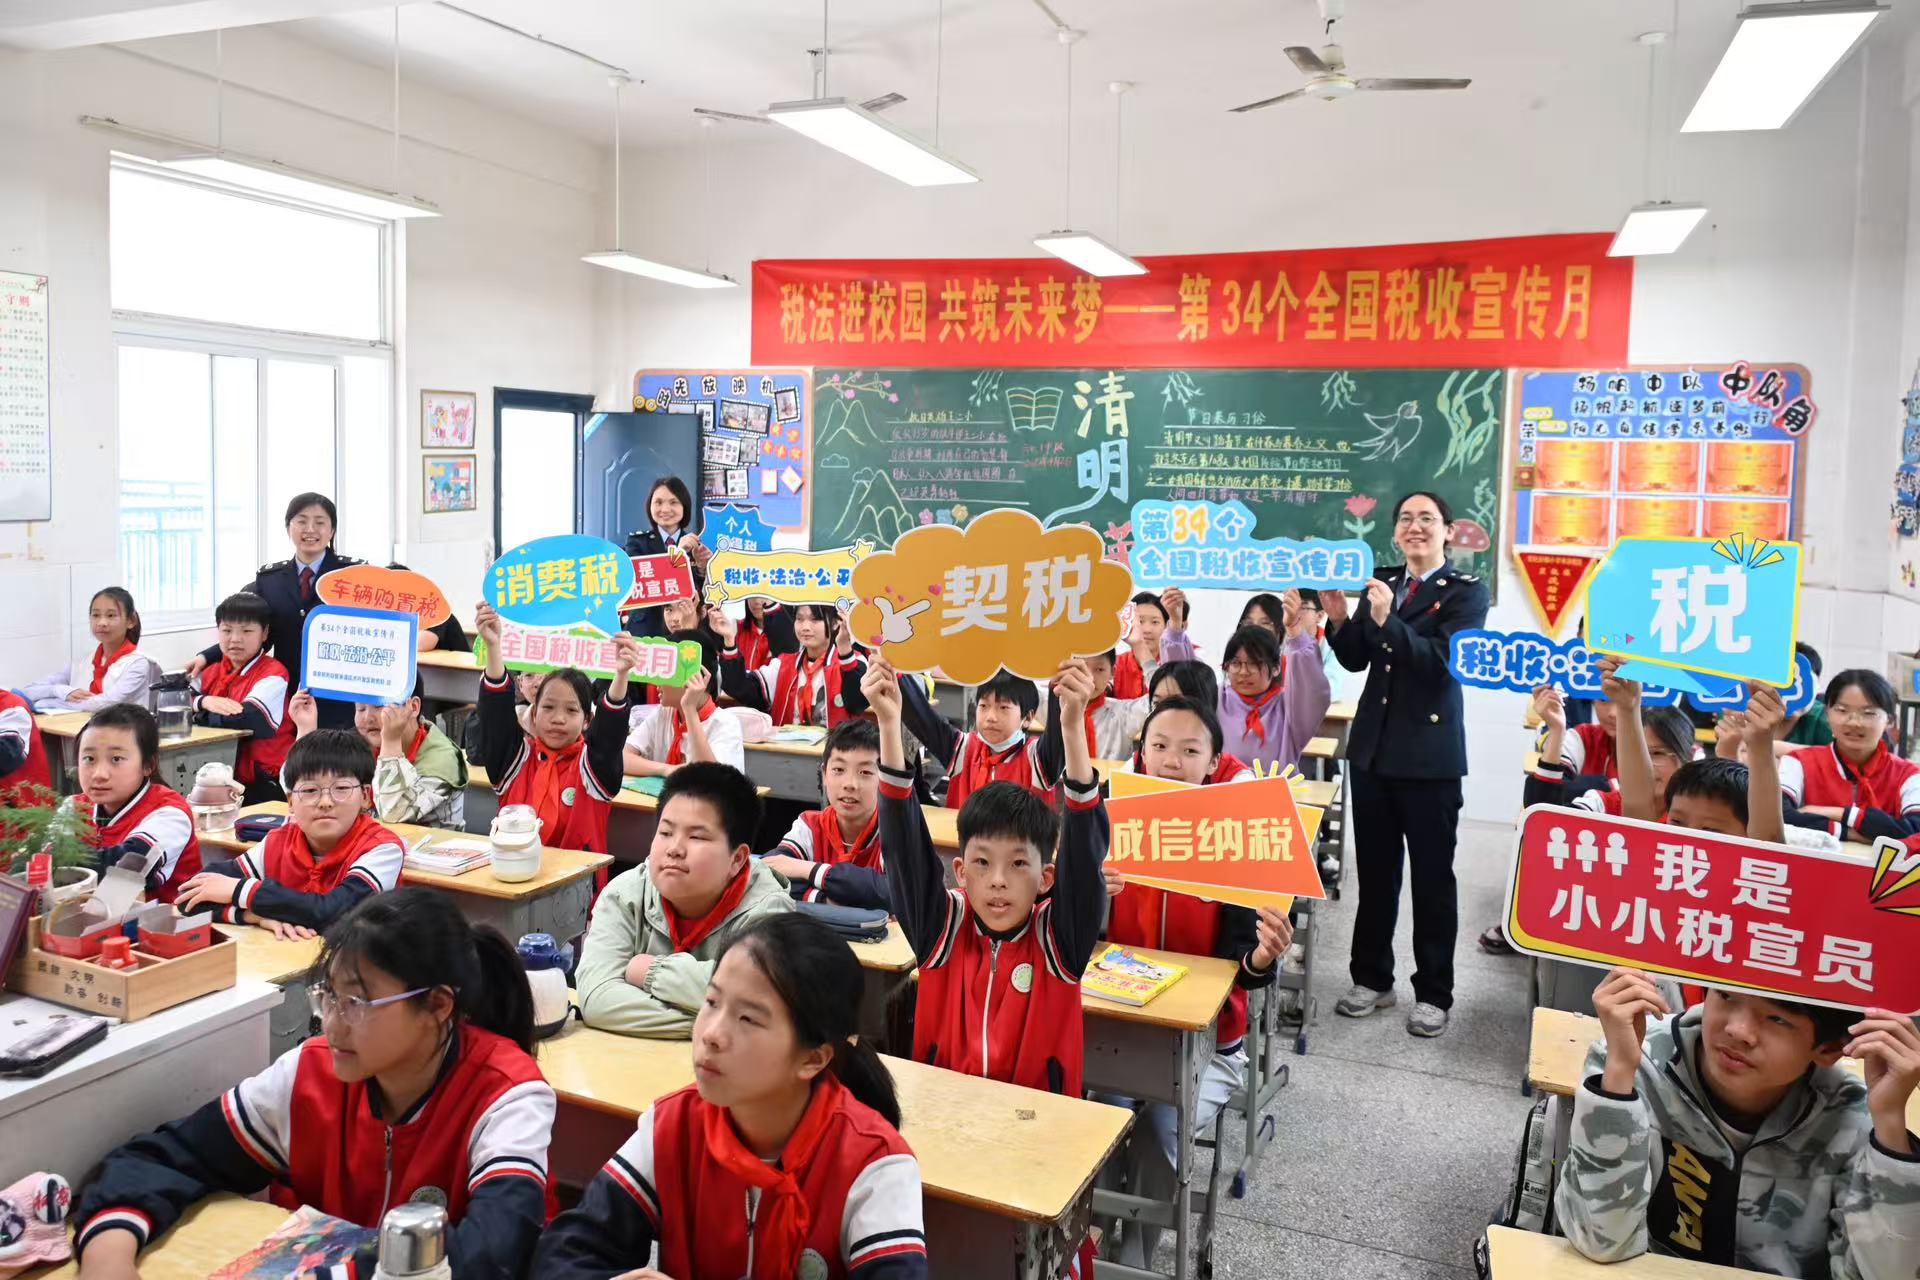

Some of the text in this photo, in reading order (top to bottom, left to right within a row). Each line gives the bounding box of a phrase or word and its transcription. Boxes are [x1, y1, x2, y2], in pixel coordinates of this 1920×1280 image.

[780, 281, 927, 344] 税法进校园
[1072, 371, 1134, 504] 清明
[725, 516, 752, 536] 个人
[1141, 506, 1245, 541] 第34个
[495, 552, 622, 607] 消费税
[639, 560, 654, 578] 是
[1138, 548, 1364, 580] 全国税收宣传月
[331, 579, 440, 618] 车辆购置税
[940, 554, 1092, 636] 契税
[1650, 564, 1751, 654] 税
[1653, 842, 1793, 915] 我是
[1549, 884, 1875, 992] 小小税宣员
